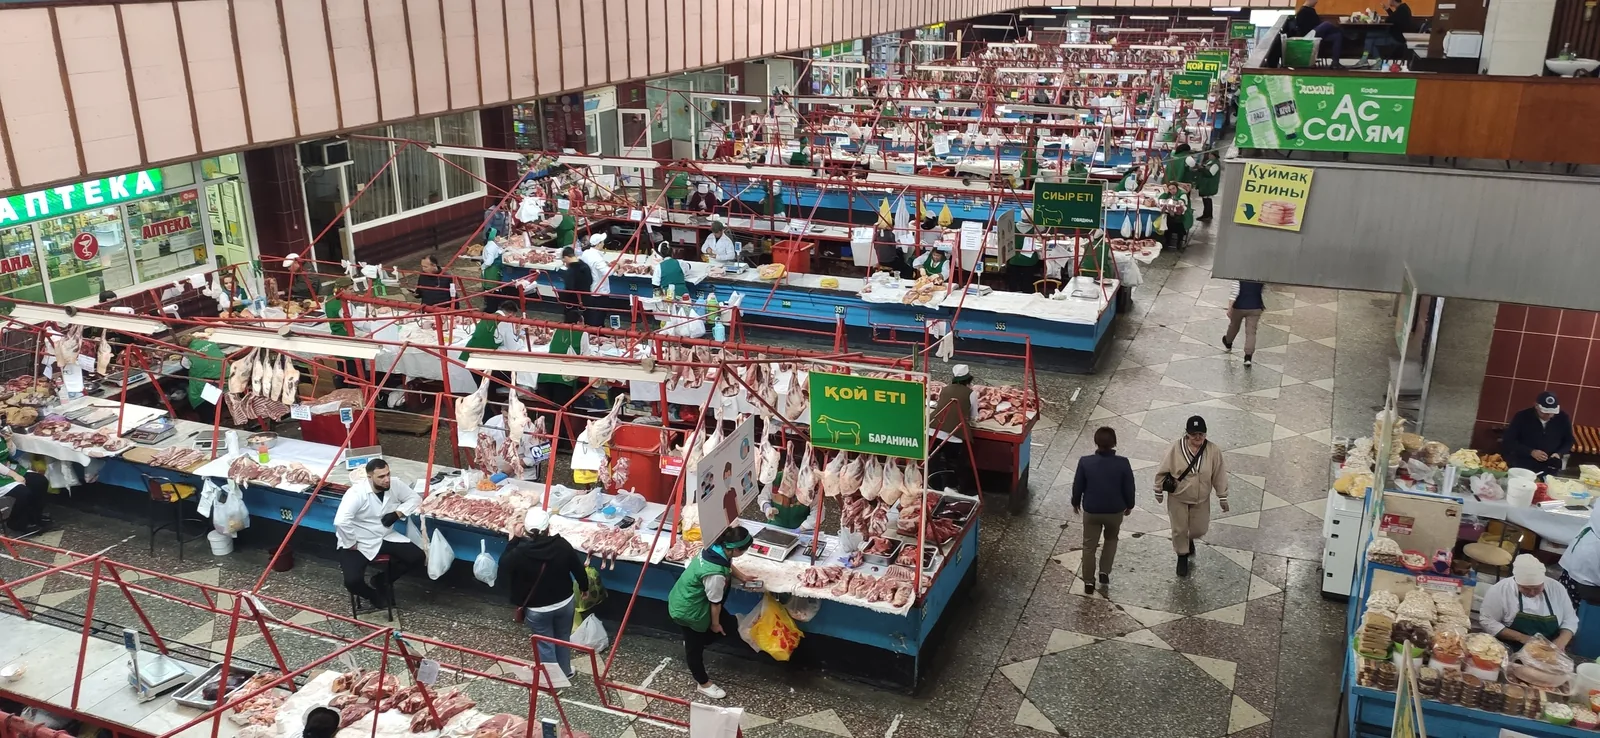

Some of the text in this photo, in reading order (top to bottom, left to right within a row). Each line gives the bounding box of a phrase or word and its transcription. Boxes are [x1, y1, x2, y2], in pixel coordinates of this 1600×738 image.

[1205, 63, 1217, 71] ЕТІ
[1248, 164, 1308, 184] Құймақ
[0, 171, 155, 223] АПТЕКА
[1042, 191, 1094, 202] СИЫР ЕТІ
[1245, 180, 1304, 199] Блины
[142, 216, 191, 239] АПТЕКА
[995, 322, 1006, 330] 355
[824, 385, 906, 404] ҚОЙ ЕТІ
[868, 433, 919, 447] БАРАНИНА
[281, 509, 293, 520] 338
